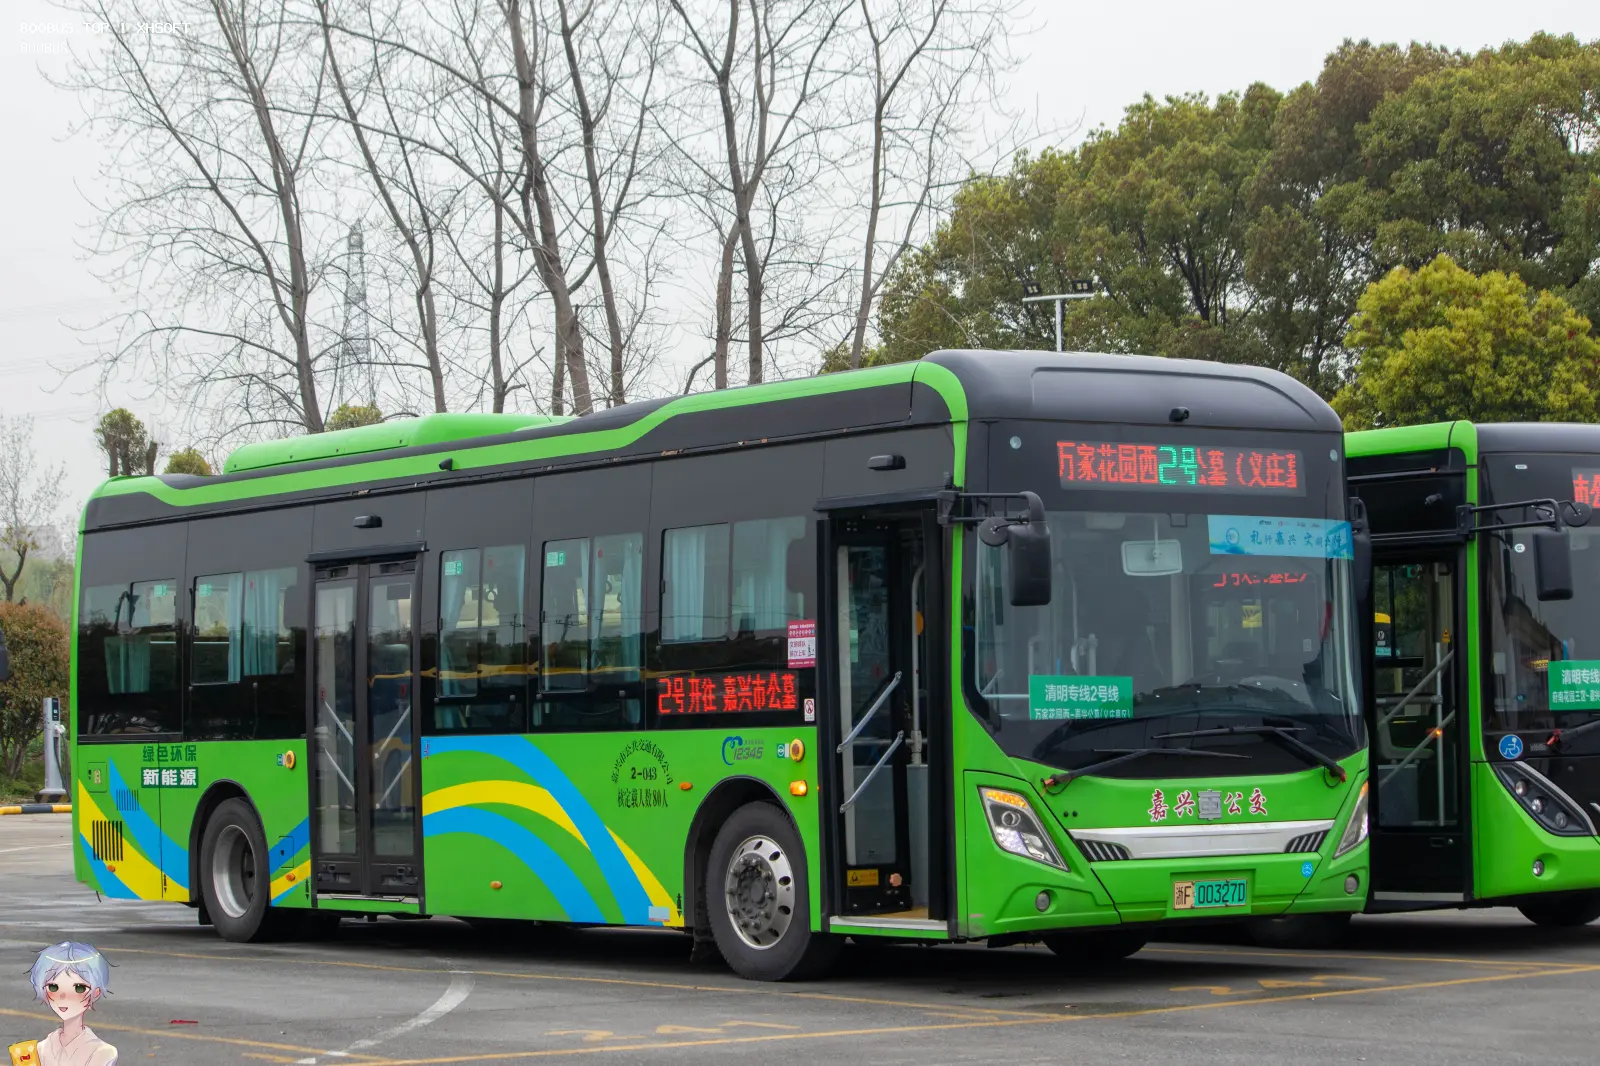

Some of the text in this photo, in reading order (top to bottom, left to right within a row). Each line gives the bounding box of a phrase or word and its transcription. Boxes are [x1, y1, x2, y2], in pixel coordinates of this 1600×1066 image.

[658, 672, 797, 714] 2号开往 嘉兴市公墓
[1045, 684, 1119, 702] 清明专线2号线
[142, 745, 197, 762] 绿色环保
[733, 747, 763, 760] 12345
[142, 768, 197, 786] 新能源
[631, 766, 657, 780] 2-043
[1148, 788, 1267, 822] 嘉兴 公交
